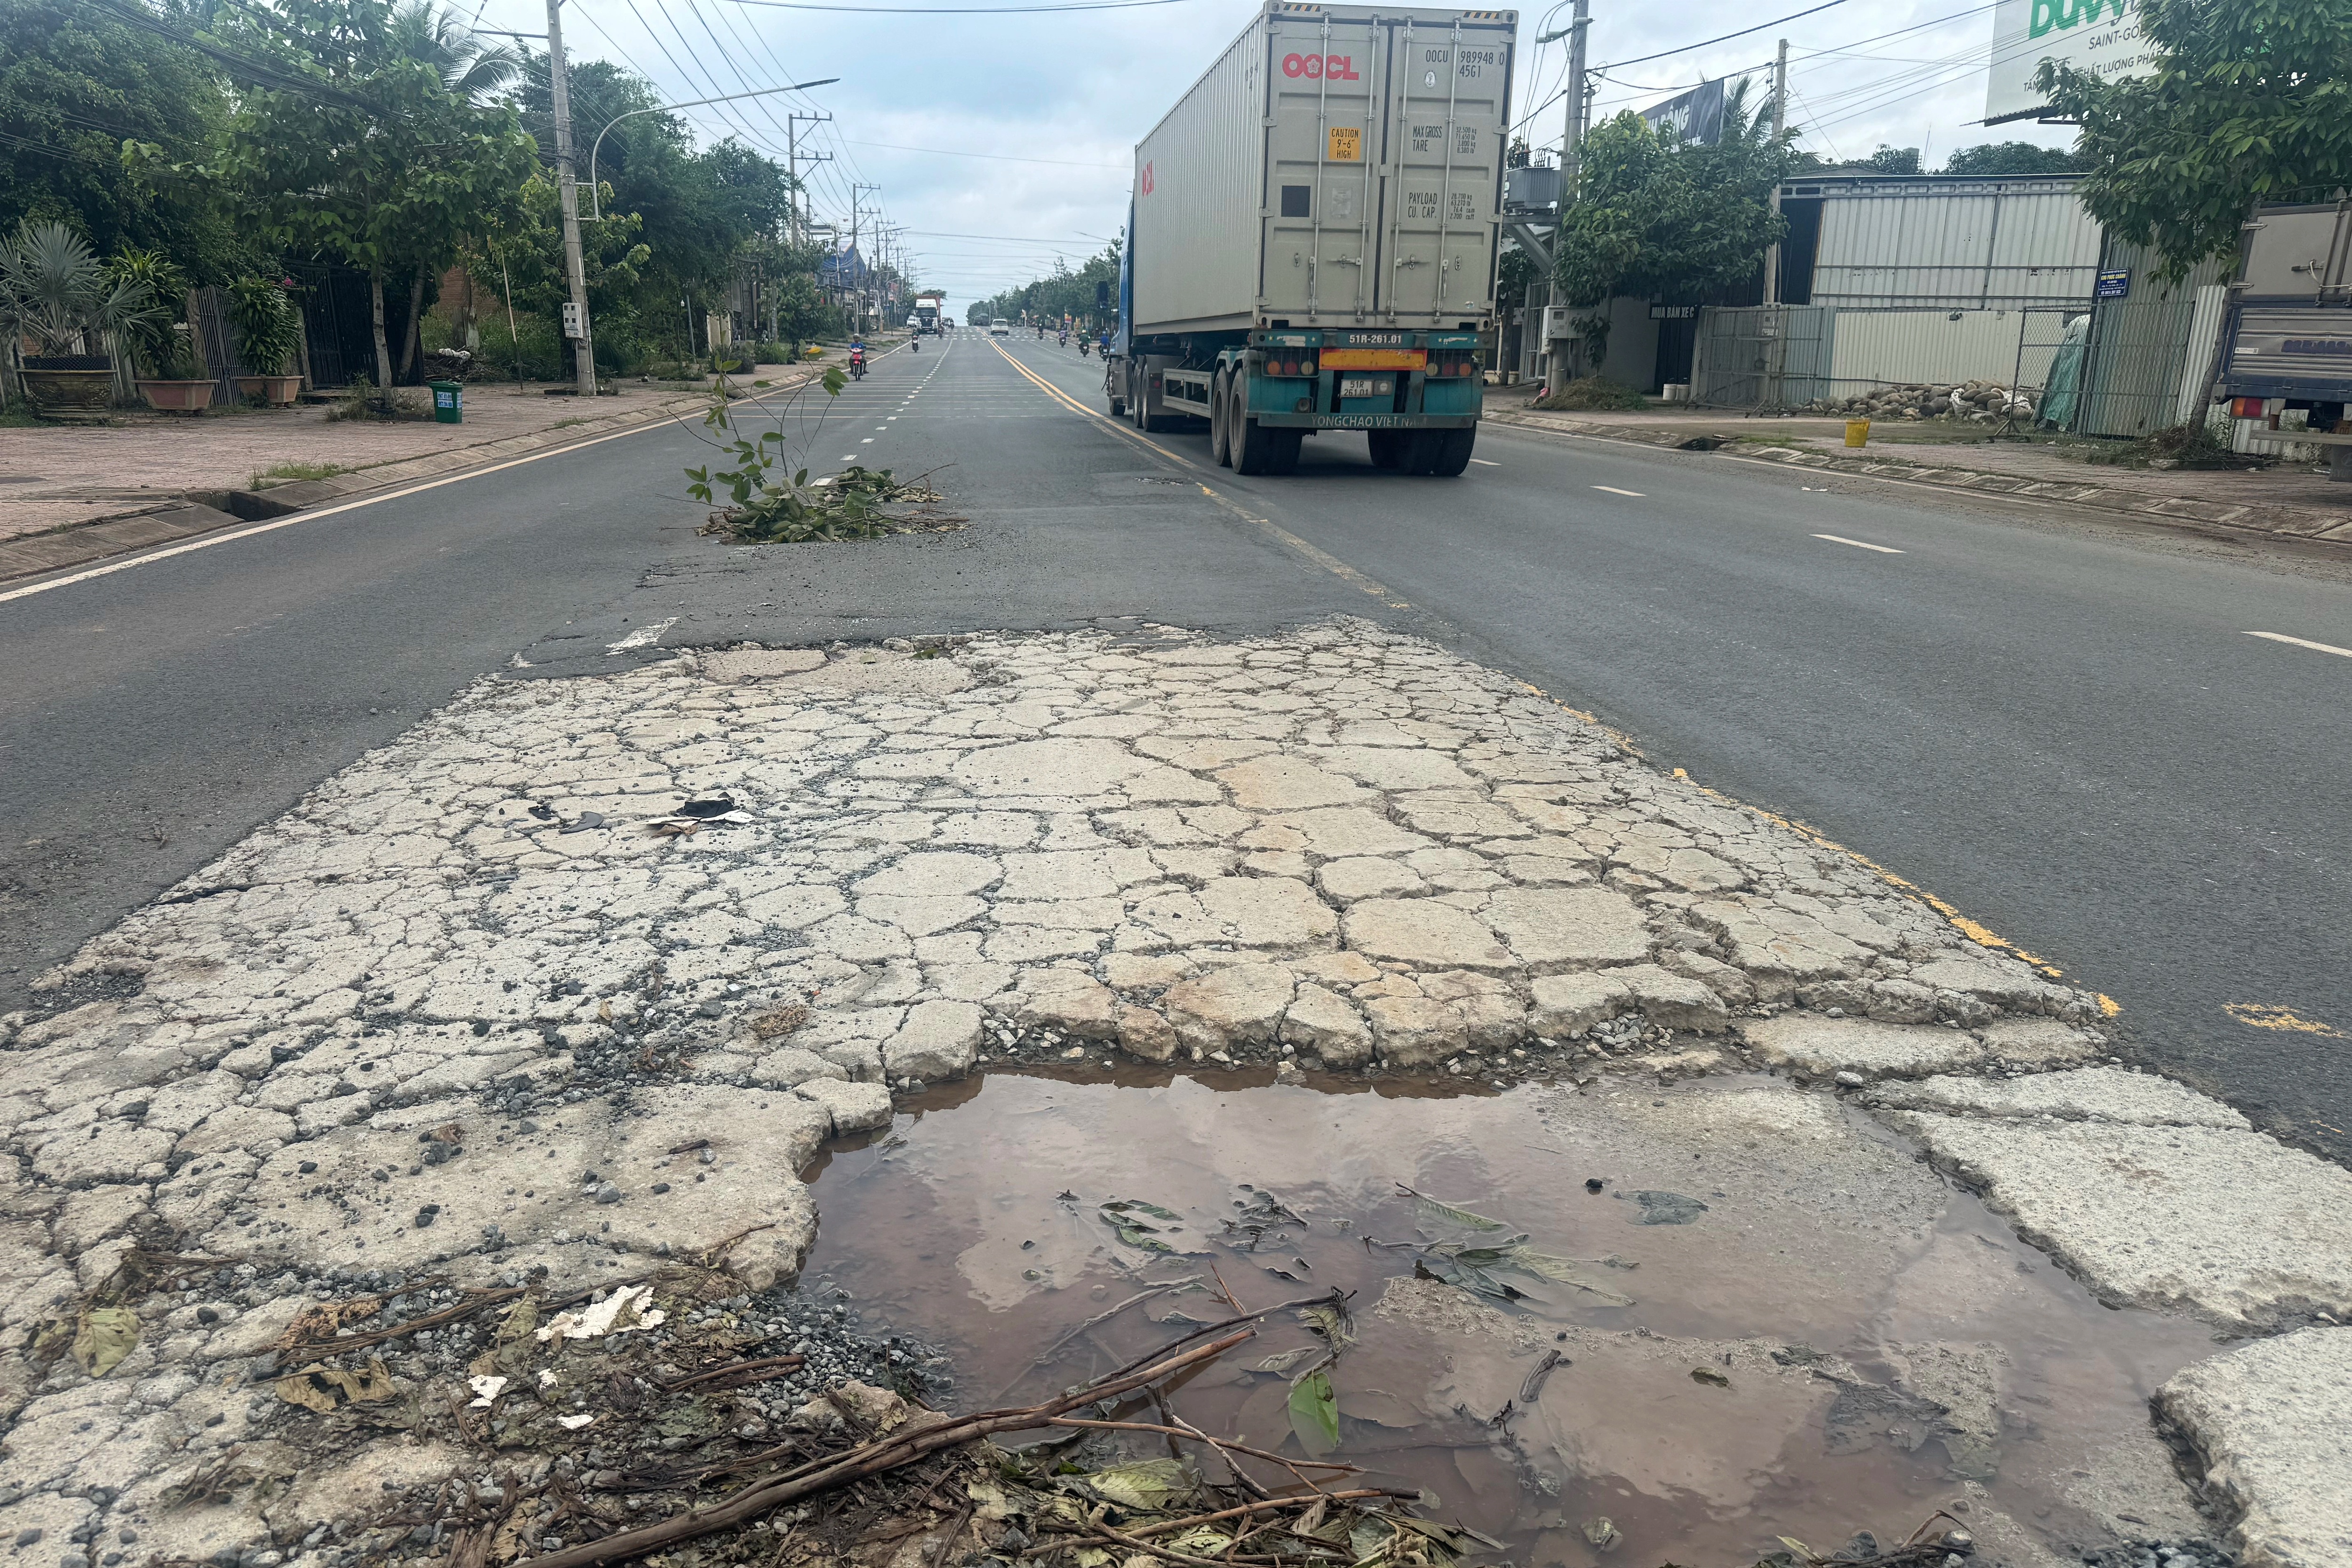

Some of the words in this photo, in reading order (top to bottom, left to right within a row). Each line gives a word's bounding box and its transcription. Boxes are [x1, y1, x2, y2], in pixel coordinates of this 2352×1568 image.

[2089, 25, 2144, 50] SAINT-GO
[1426, 50, 1448, 63] OOCU
[1461, 51, 1494, 64] 989948
[1499, 52, 1505, 65] 0
[1282, 53, 1359, 80] OOCL
[1460, 65, 1481, 78] 45G1
[2103, 57, 2134, 74] LƯỢNG
[1332, 128, 1359, 138] CAUTION
[1413, 125, 1424, 138] MAX
[1425, 126, 1442, 138] GROSS
[1413, 140, 1428, 152] TARE
[1337, 150, 1351, 159] HIGH
[1409, 192, 1437, 205] PAYLOAD
[1408, 206, 1418, 218] CU.
[1422, 206, 1437, 218] CAP.
[1651, 307, 1665, 318] MUA
[1667, 304, 1680, 318] BÁN
[1681, 307, 1689, 318] XE
[1349, 334, 1401, 343] 51R-261.01
[1311, 416, 1374, 427] YONGCHAO
